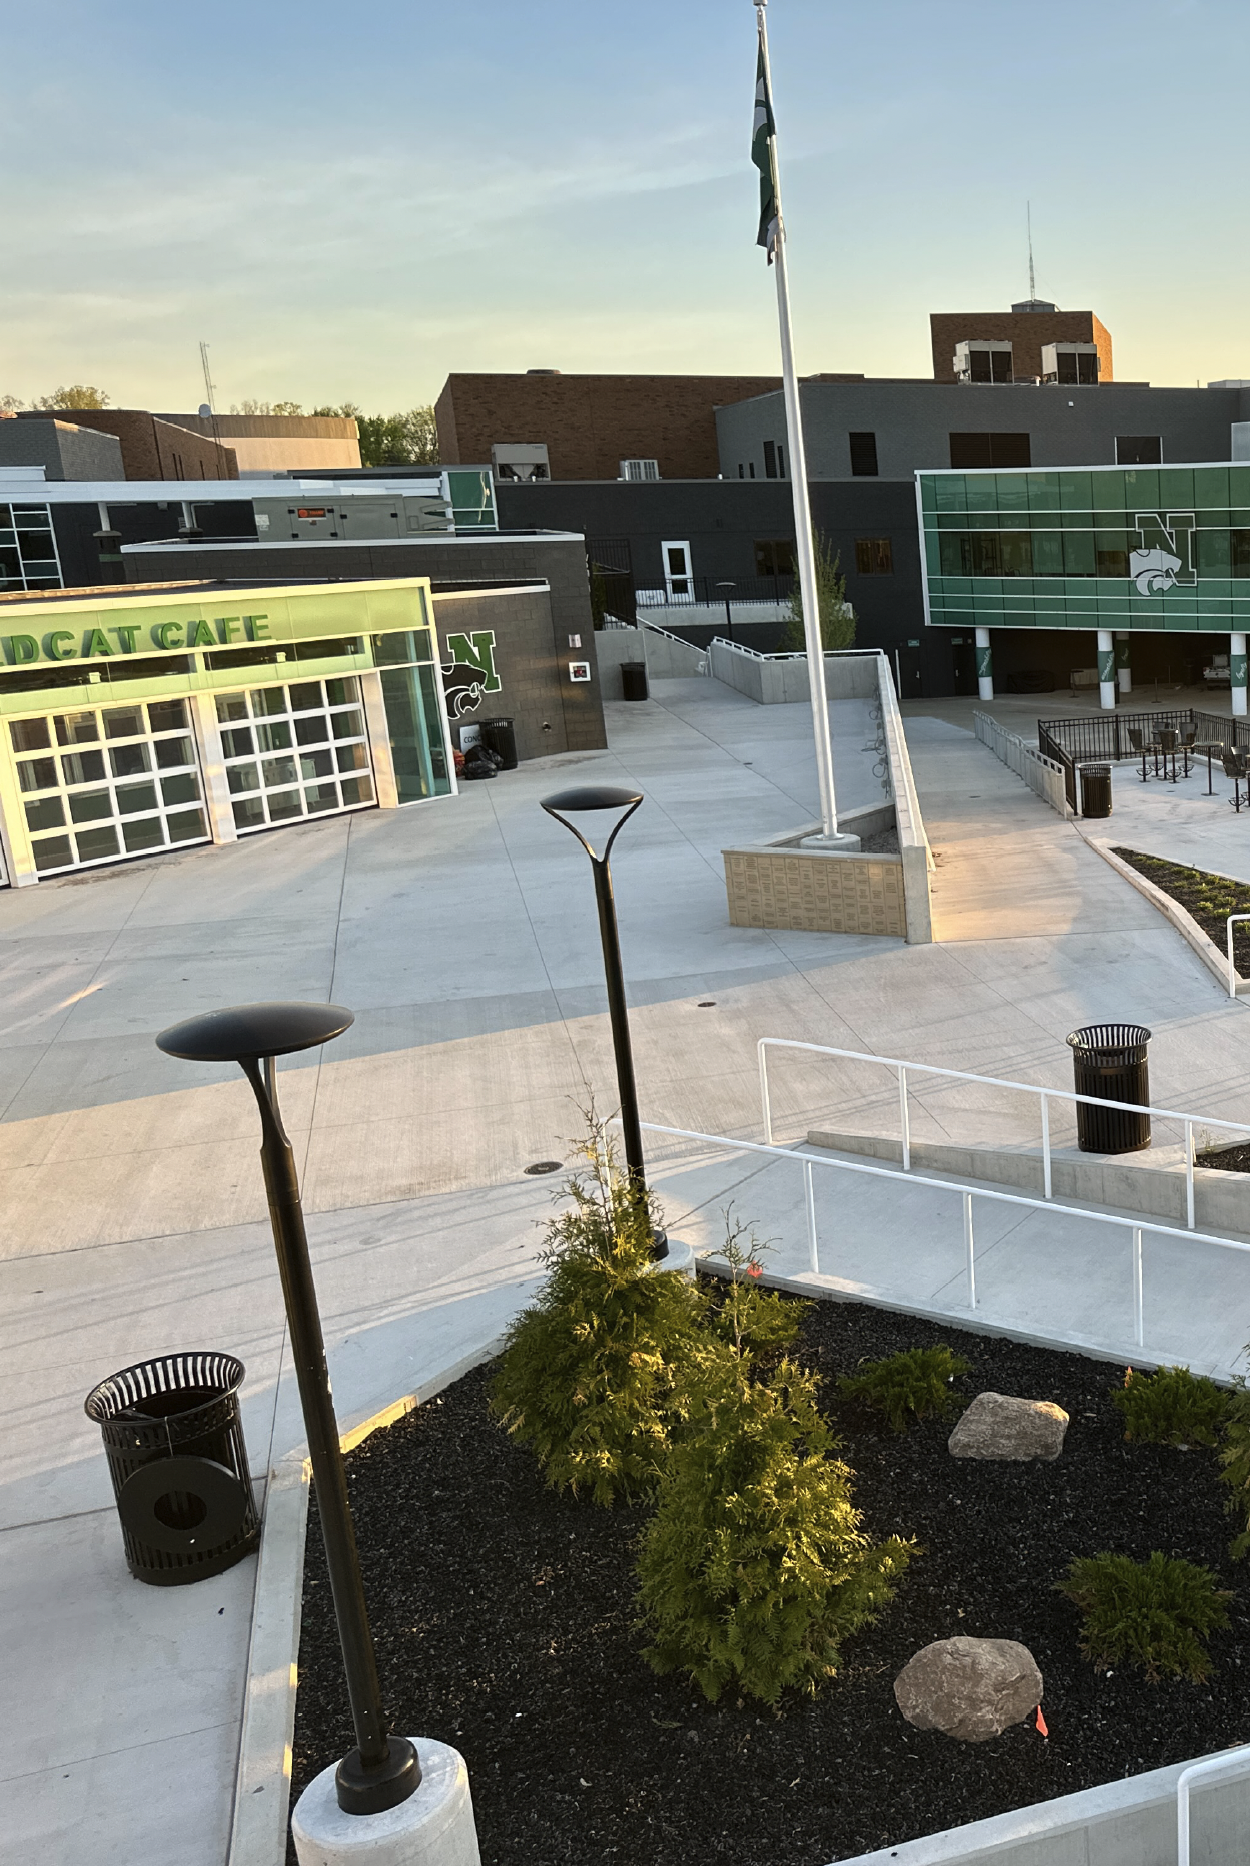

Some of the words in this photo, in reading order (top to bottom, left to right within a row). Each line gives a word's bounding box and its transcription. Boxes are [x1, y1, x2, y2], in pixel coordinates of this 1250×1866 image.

[0, 625, 142, 666] DCAT
[160, 614, 272, 650] CAFE
[446, 630, 502, 693] N
